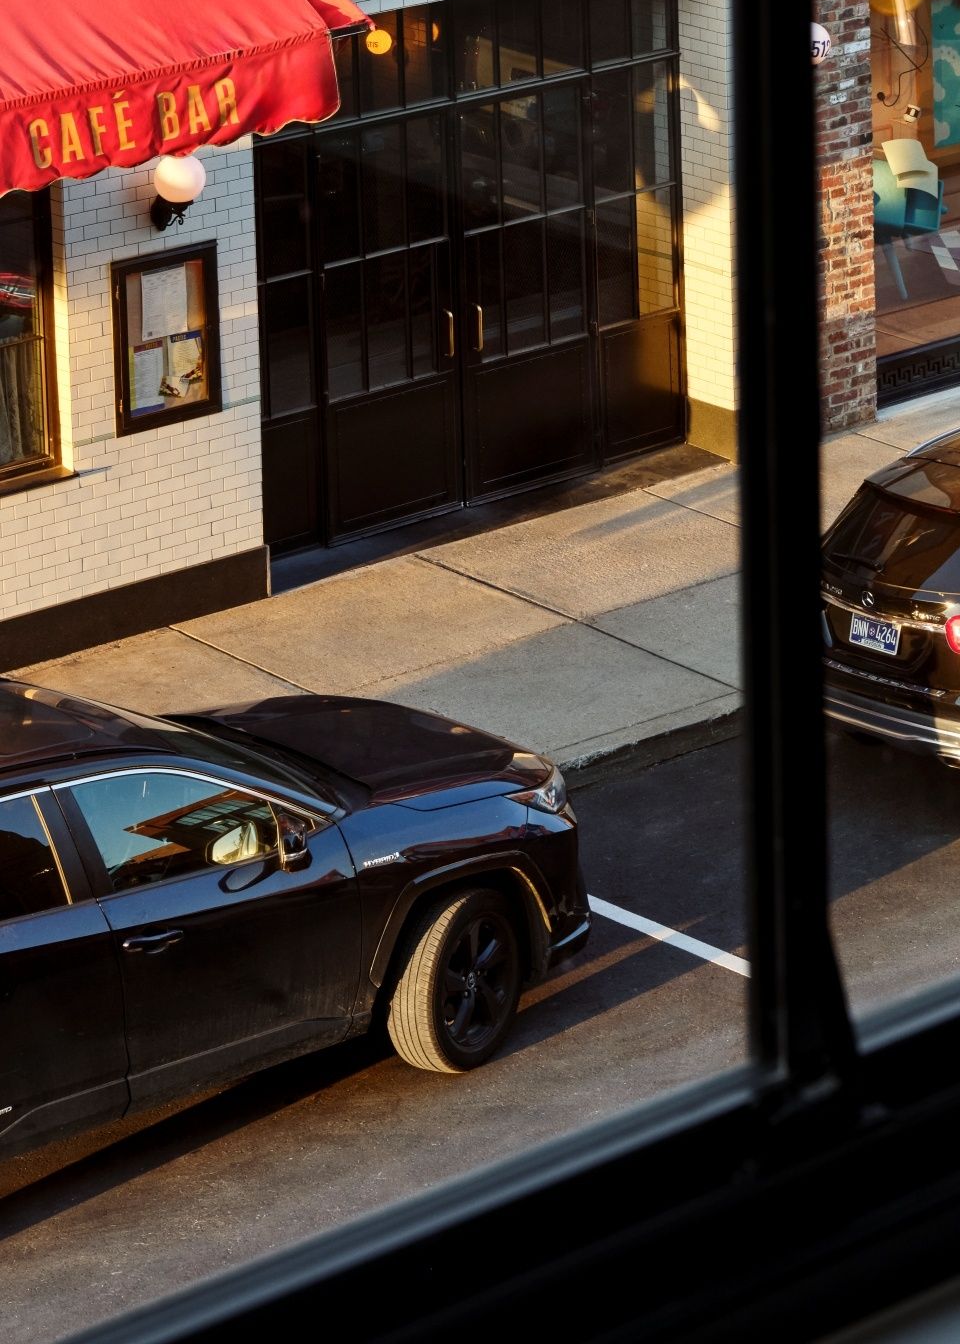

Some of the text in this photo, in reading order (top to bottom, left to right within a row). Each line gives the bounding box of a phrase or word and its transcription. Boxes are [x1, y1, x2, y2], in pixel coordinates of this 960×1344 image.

[30, 77, 241, 169] CAFÉ BAR
[852, 618, 870, 638] BNN
[875, 625, 896, 646] 4264
